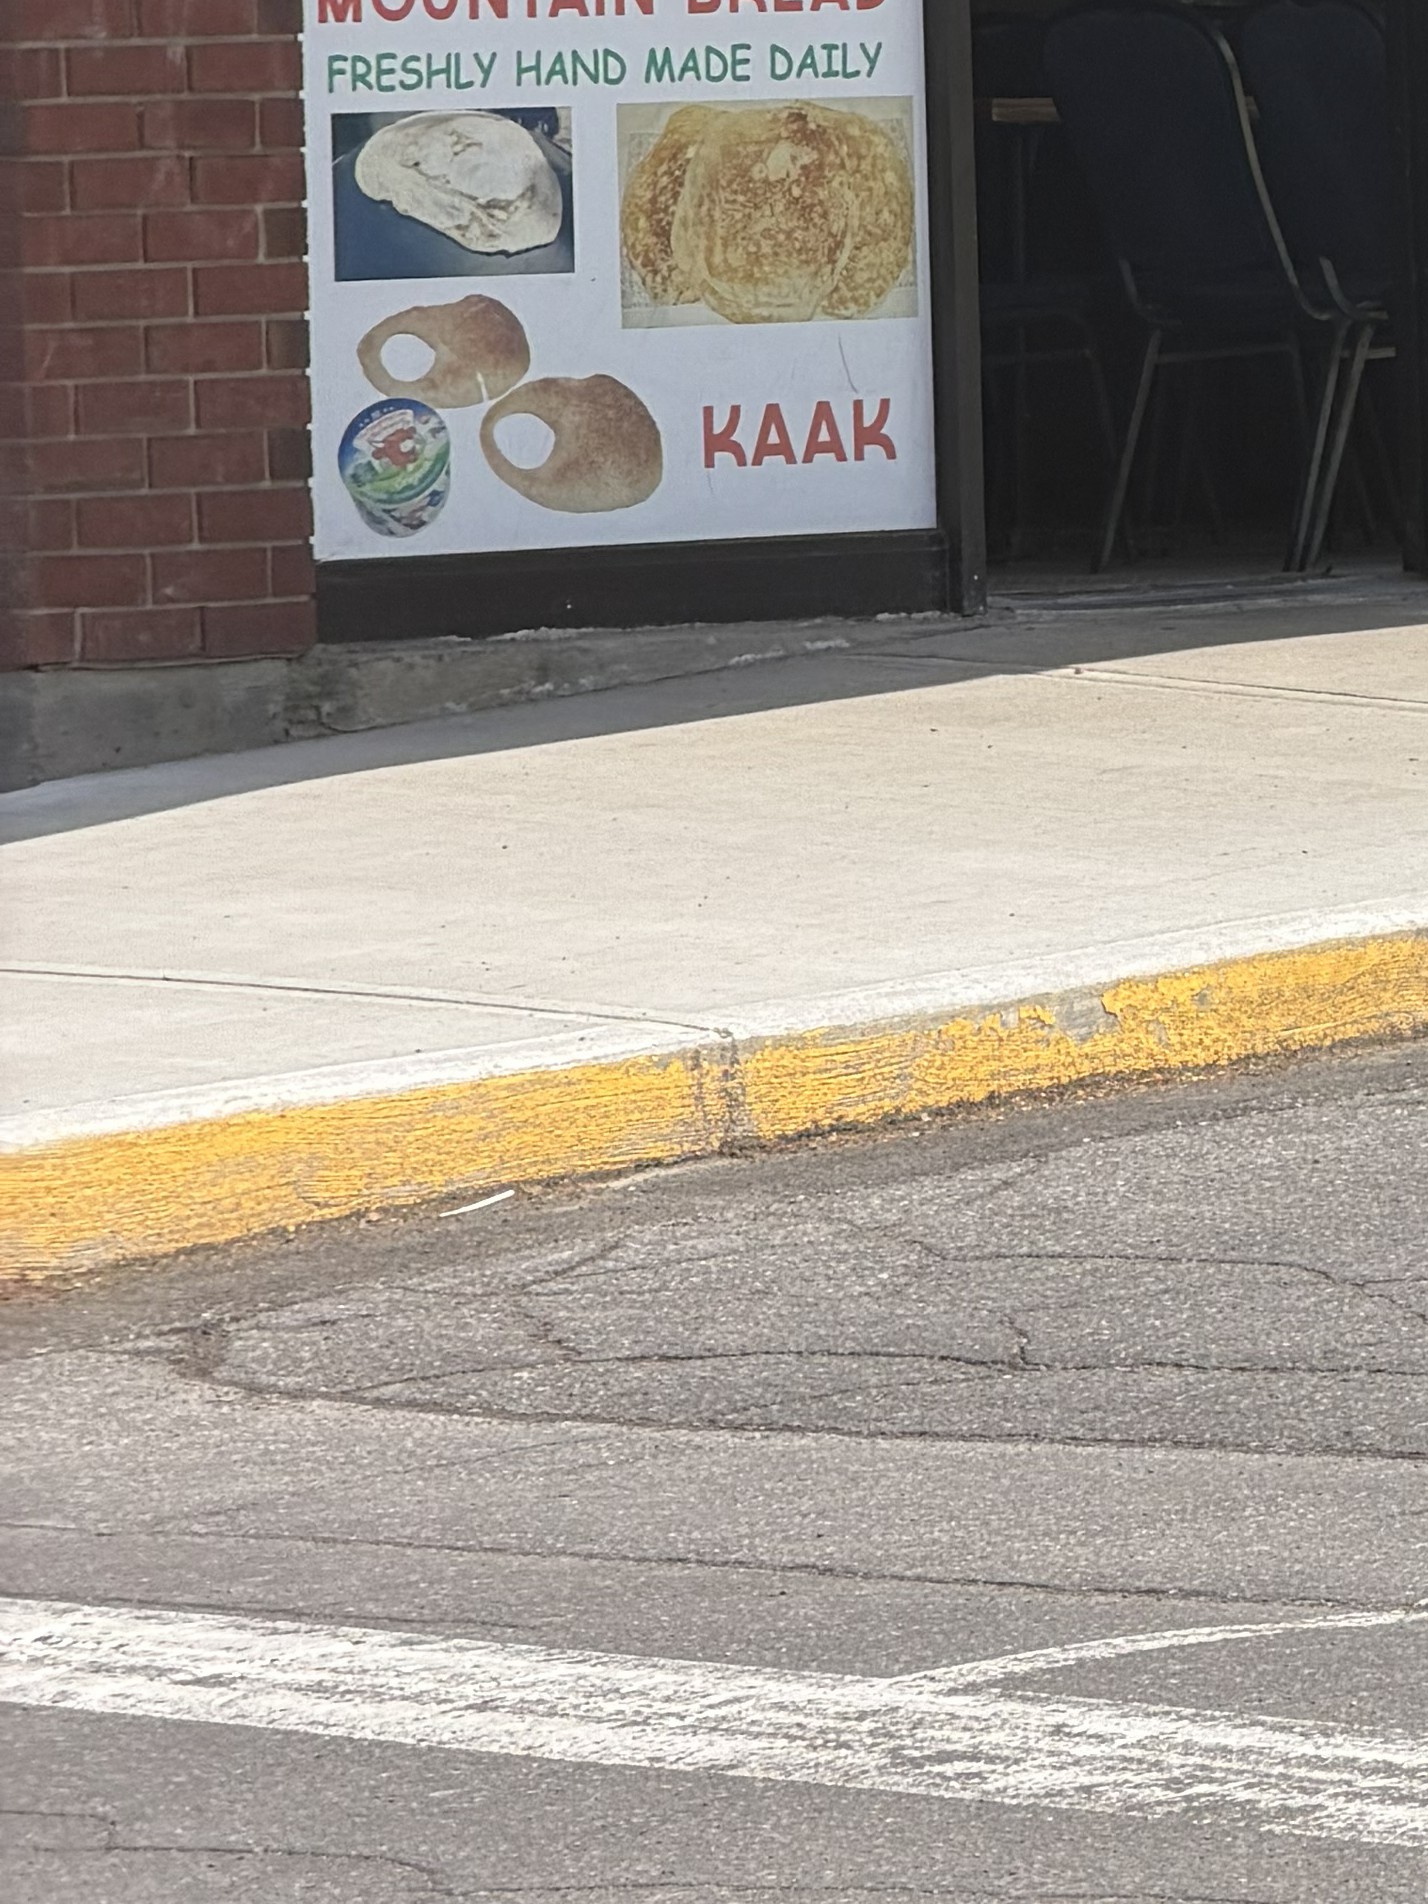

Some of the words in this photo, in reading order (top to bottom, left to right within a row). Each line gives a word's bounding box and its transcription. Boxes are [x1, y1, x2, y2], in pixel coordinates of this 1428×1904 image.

[327, 51, 497, 93] FRESHLY
[515, 49, 627, 87] HAND
[644, 43, 753, 85] MADE
[769, 41, 883, 82] DAILY
[703, 398, 897, 469] KAAK
